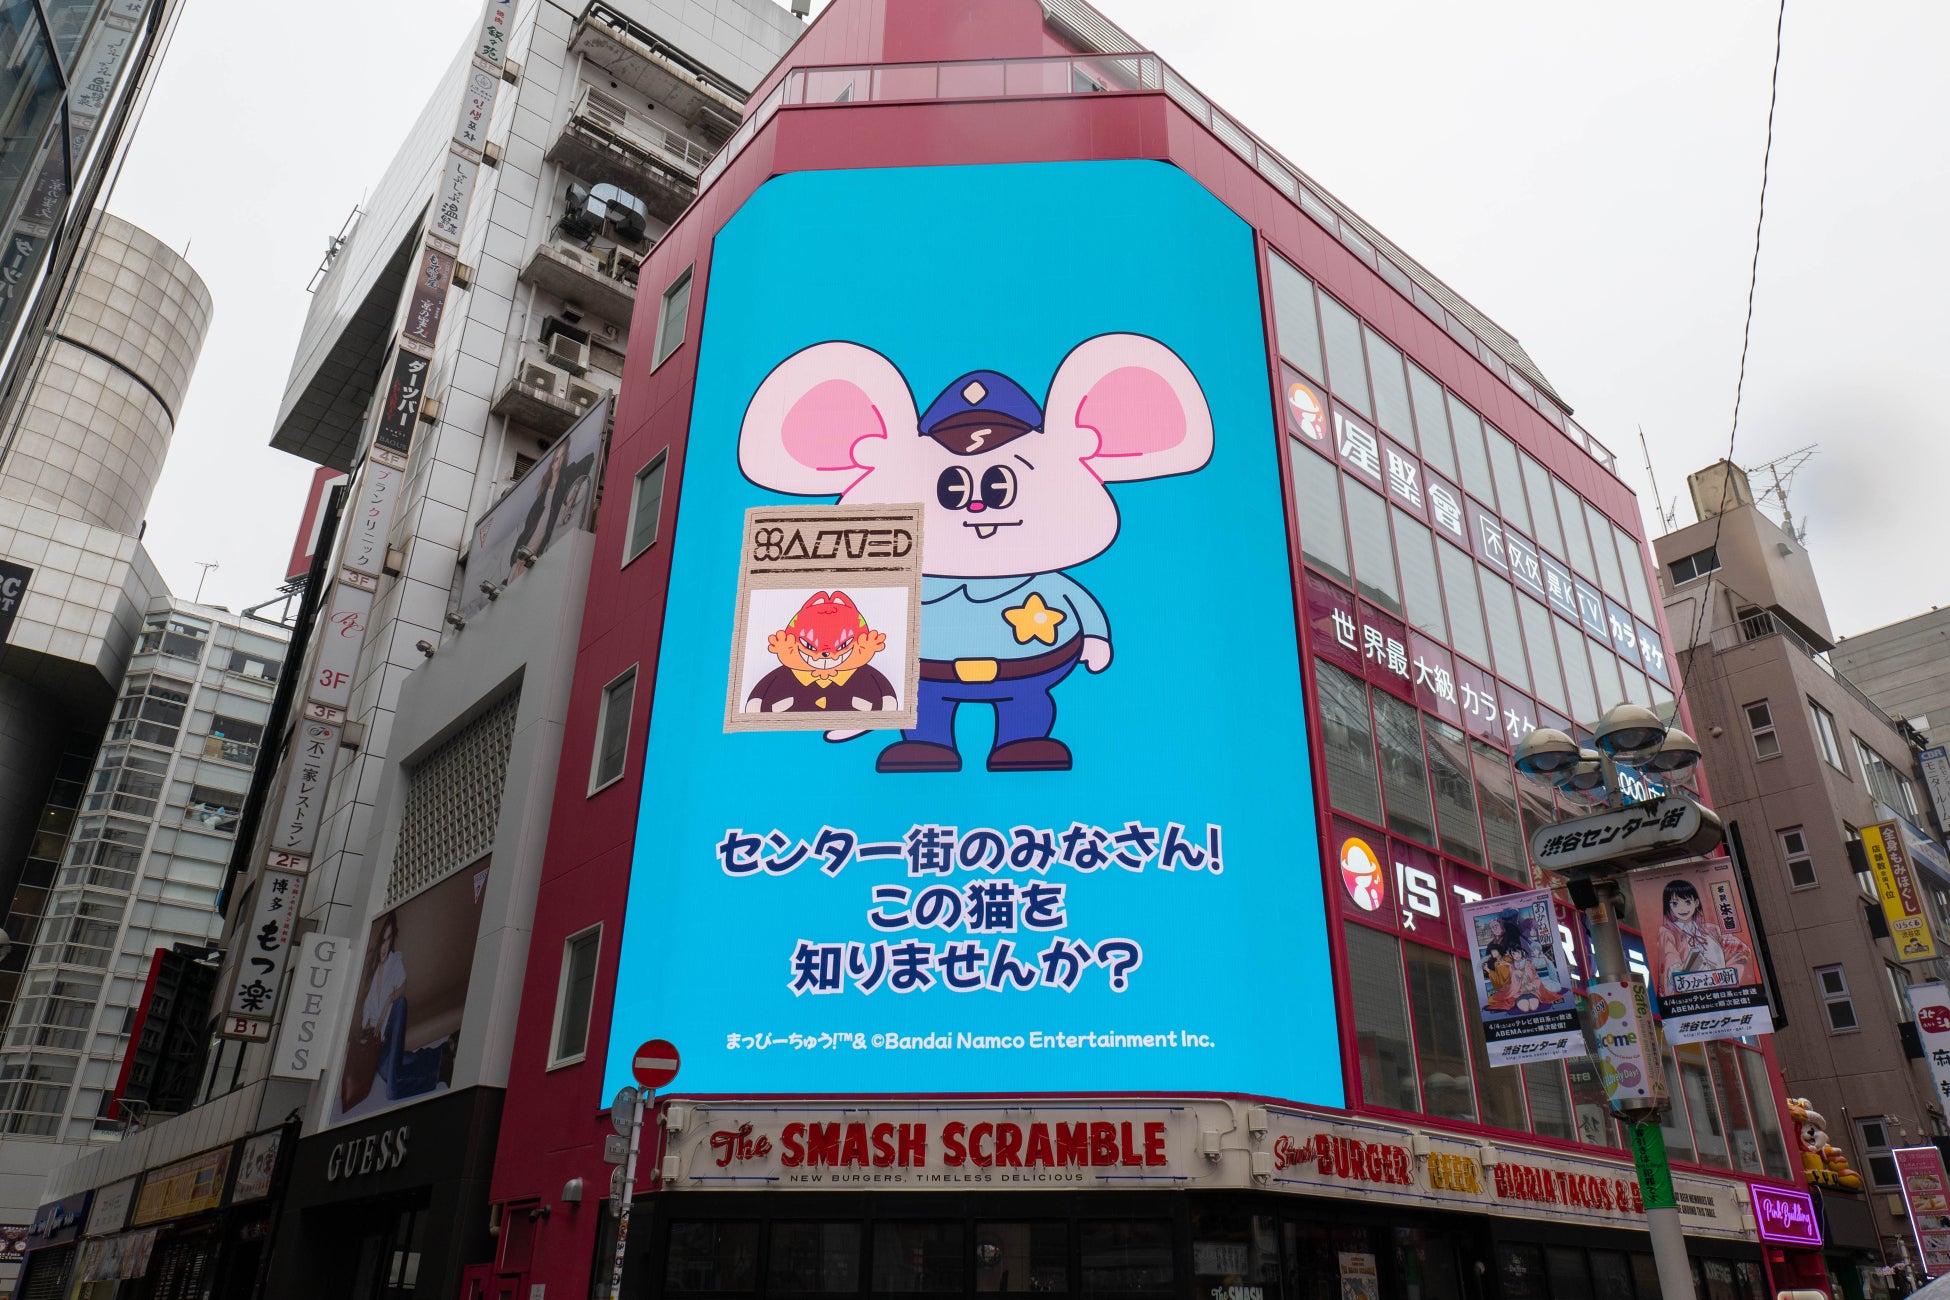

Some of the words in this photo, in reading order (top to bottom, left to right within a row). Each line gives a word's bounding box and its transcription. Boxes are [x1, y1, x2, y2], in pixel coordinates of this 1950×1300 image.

[482, 26, 504, 61] 叙々苑
[463, 98, 485, 142] 인생포차
[397, 361, 427, 426] ダーツバー
[379, 450, 400, 464] 4F
[348, 571, 370, 587] 3F
[1486, 527, 1600, 624] 不仅仅是KTV
[1609, 613, 1664, 671] カラオケ
[319, 668, 350, 690] 3F
[314, 705, 337, 720] 3F
[1921, 749, 1942, 760] CBR
[287, 740, 326, 849] 不二家レストラン
[1925, 762, 1950, 821] モニタールーム
[716, 820, 1224, 878] センター街のみなさん!
[1540, 806, 1687, 857] 渋谷センター街
[275, 852, 301, 868] 2F
[1882, 828, 1917, 913] 全身もみほぐし
[267, 878, 289, 912] 博多
[867, 879, 1067, 933] この猫を
[1896, 920, 1921, 929] りらくる
[238, 919, 281, 1012] もつ楽
[787, 938, 1143, 995] 知りませんか?
[290, 941, 337, 1072] GUESS
[1633, 985, 1647, 1019] Safe,
[1678, 1014, 1753, 1033] 渋谷センター街
[233, 1018, 259, 1036] B1
[957, 1032, 1024, 1049] Namco
[1029, 1030, 1178, 1049] Entertainment
[1181, 1030, 1215, 1048] Inc.
[1501, 1038, 1569, 1056] 渋谷センター街
[327, 1125, 409, 1182] GUESS
[710, 1120, 773, 1168] The
[780, 1121, 927, 1168] SMASH
[942, 1120, 1168, 1168] SCRAMBLE
[1315, 1133, 1415, 1185] BURGER
[790, 1174, 824, 1182] NEW
[831, 1174, 907, 1183] BURGERS,
[916, 1174, 992, 1182] TIMELESS
[1001, 1173, 1084, 1182] DELICIOUS
[1427, 1151, 1485, 1194] BEER
[1554, 1169, 1615, 1211] TACOS
[1615, 1179, 1630, 1213] &
